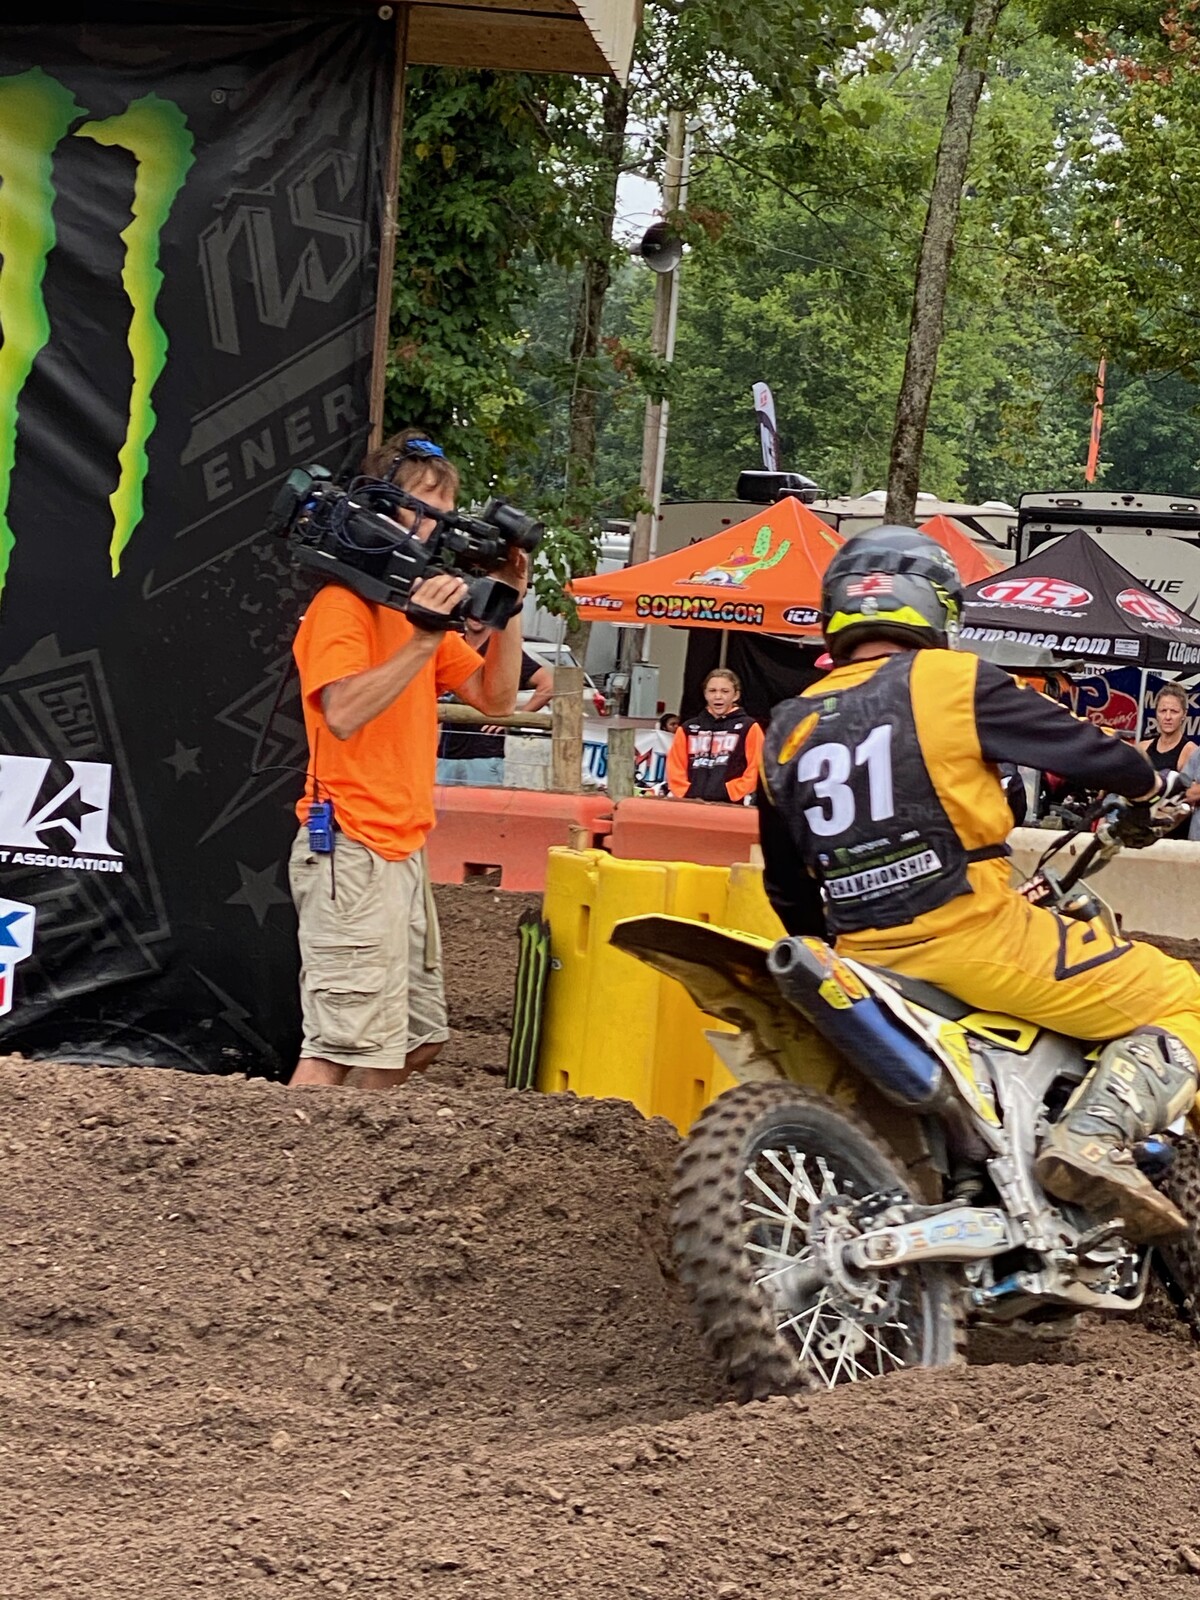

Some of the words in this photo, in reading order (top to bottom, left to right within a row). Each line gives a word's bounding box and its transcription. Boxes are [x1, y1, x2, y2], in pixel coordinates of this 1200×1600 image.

[636, 594, 765, 625] SOBMX.COM
[797, 723, 895, 837] 31
[11, 852, 123, 873] ASSOCIATION
[829, 852, 934, 897] CHAMPIONSHIP
